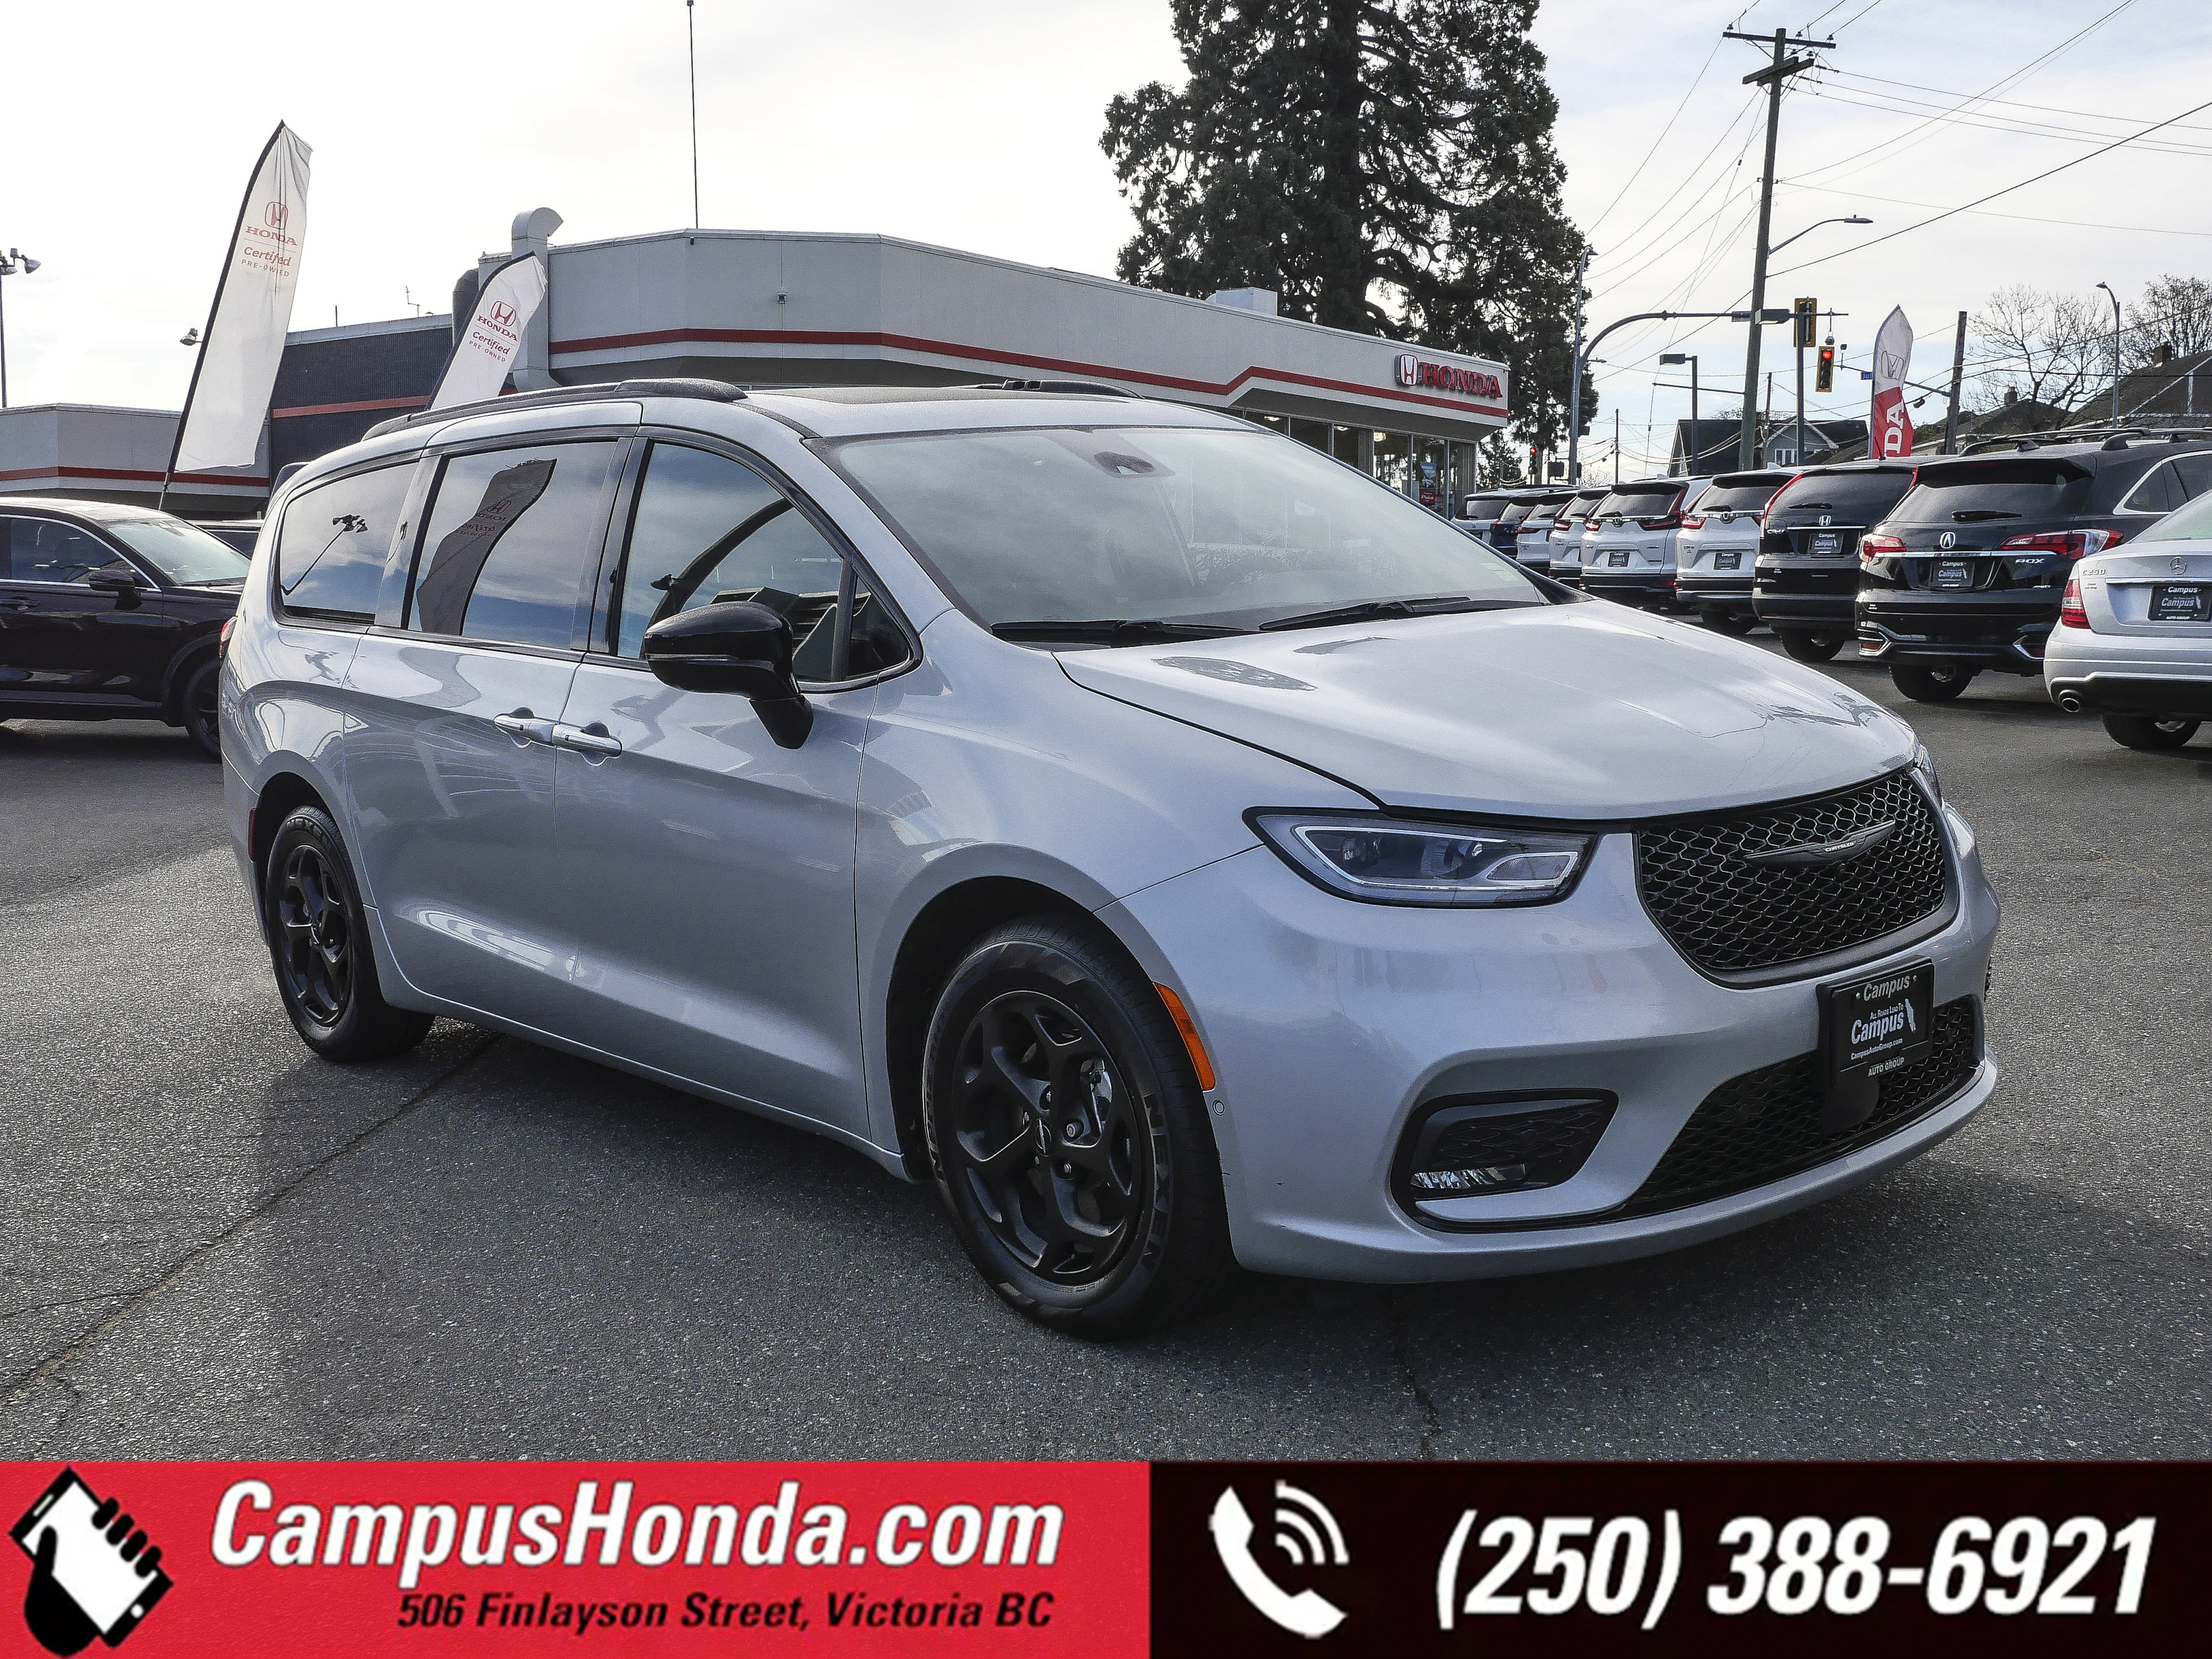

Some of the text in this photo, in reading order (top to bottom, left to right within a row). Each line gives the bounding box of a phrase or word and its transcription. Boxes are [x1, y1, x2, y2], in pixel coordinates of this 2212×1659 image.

[245, 225, 298, 247] HONDA
[241, 259, 290, 277] PRE-OWED
[243, 247, 292, 267] Certifed
[476, 315, 518, 343] HONDA
[469, 340, 506, 363] PRE-OWNED
[472, 331, 511, 355] Certified
[1420, 362, 1503, 398] HONDA
[1884, 398, 1905, 456] DA
[1938, 570, 1962, 578] Campus
[2161, 598, 2194, 608] Campus
[1863, 975, 1910, 1002] Campus
[1851, 1012, 1904, 1045] Campus
[1851, 1038, 1902, 1060] CampusAutoGroup.com
[1868, 1057, 1905, 1077] AUTO GROUP
[1143, 1091, 1171, 1270] NEXEN
